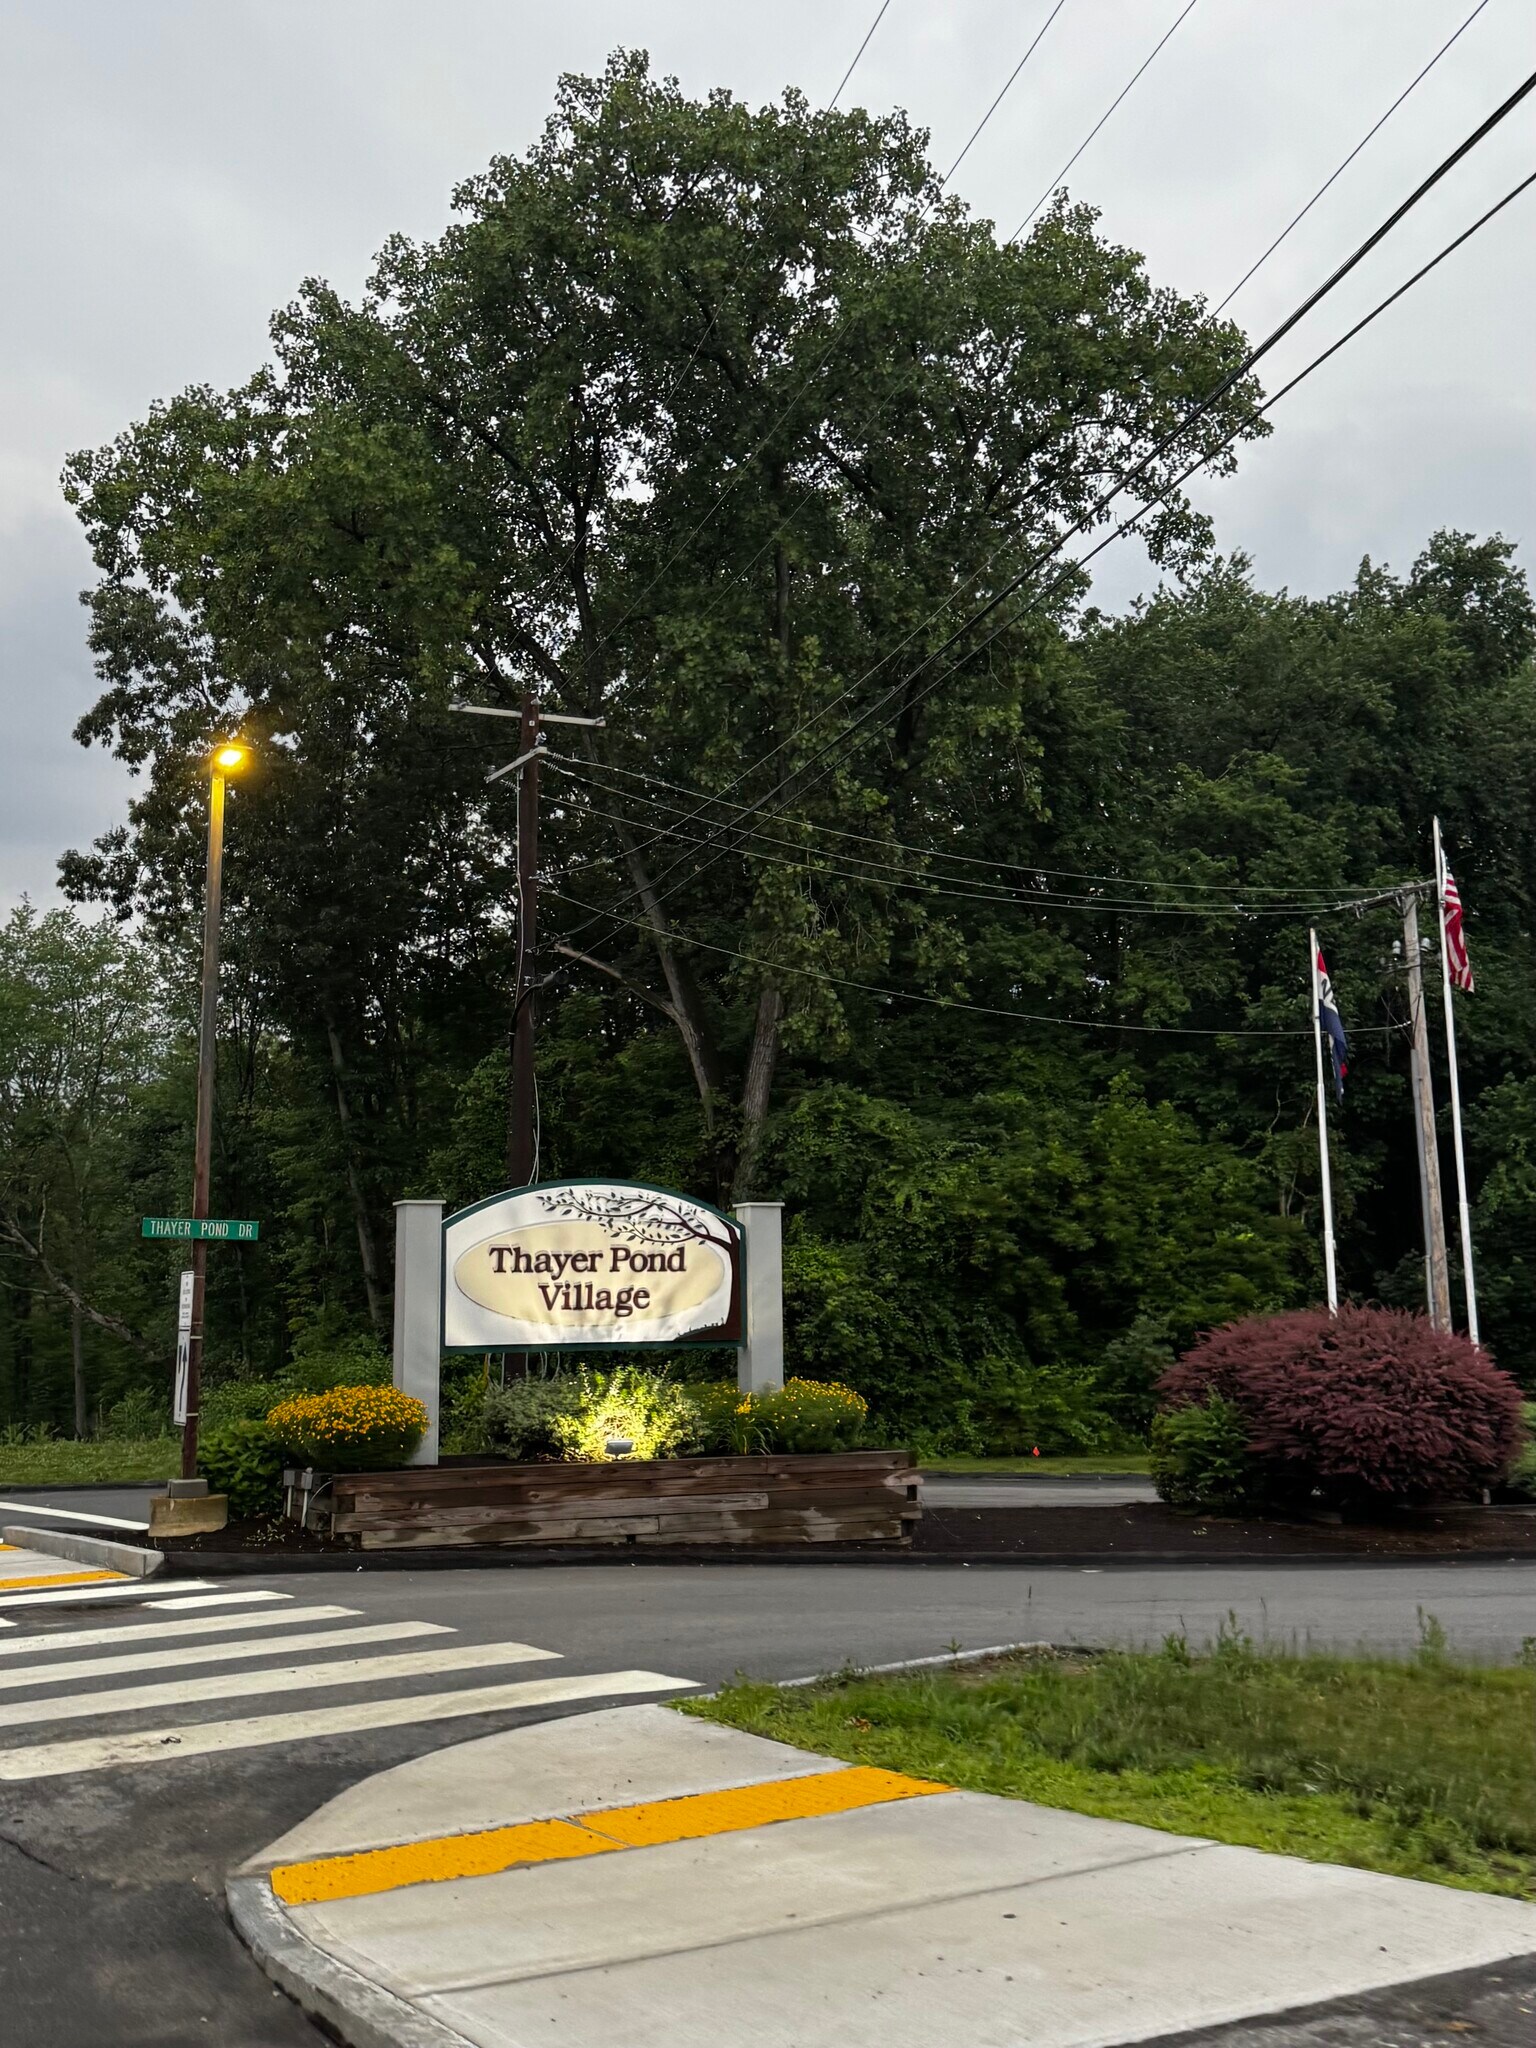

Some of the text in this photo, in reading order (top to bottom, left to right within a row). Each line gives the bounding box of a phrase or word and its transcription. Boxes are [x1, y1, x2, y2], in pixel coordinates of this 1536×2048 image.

[150, 1220, 253, 1238] THAYER POND DR
[489, 1245, 687, 1281] Thayer Pond
[538, 1281, 651, 1318] Village
